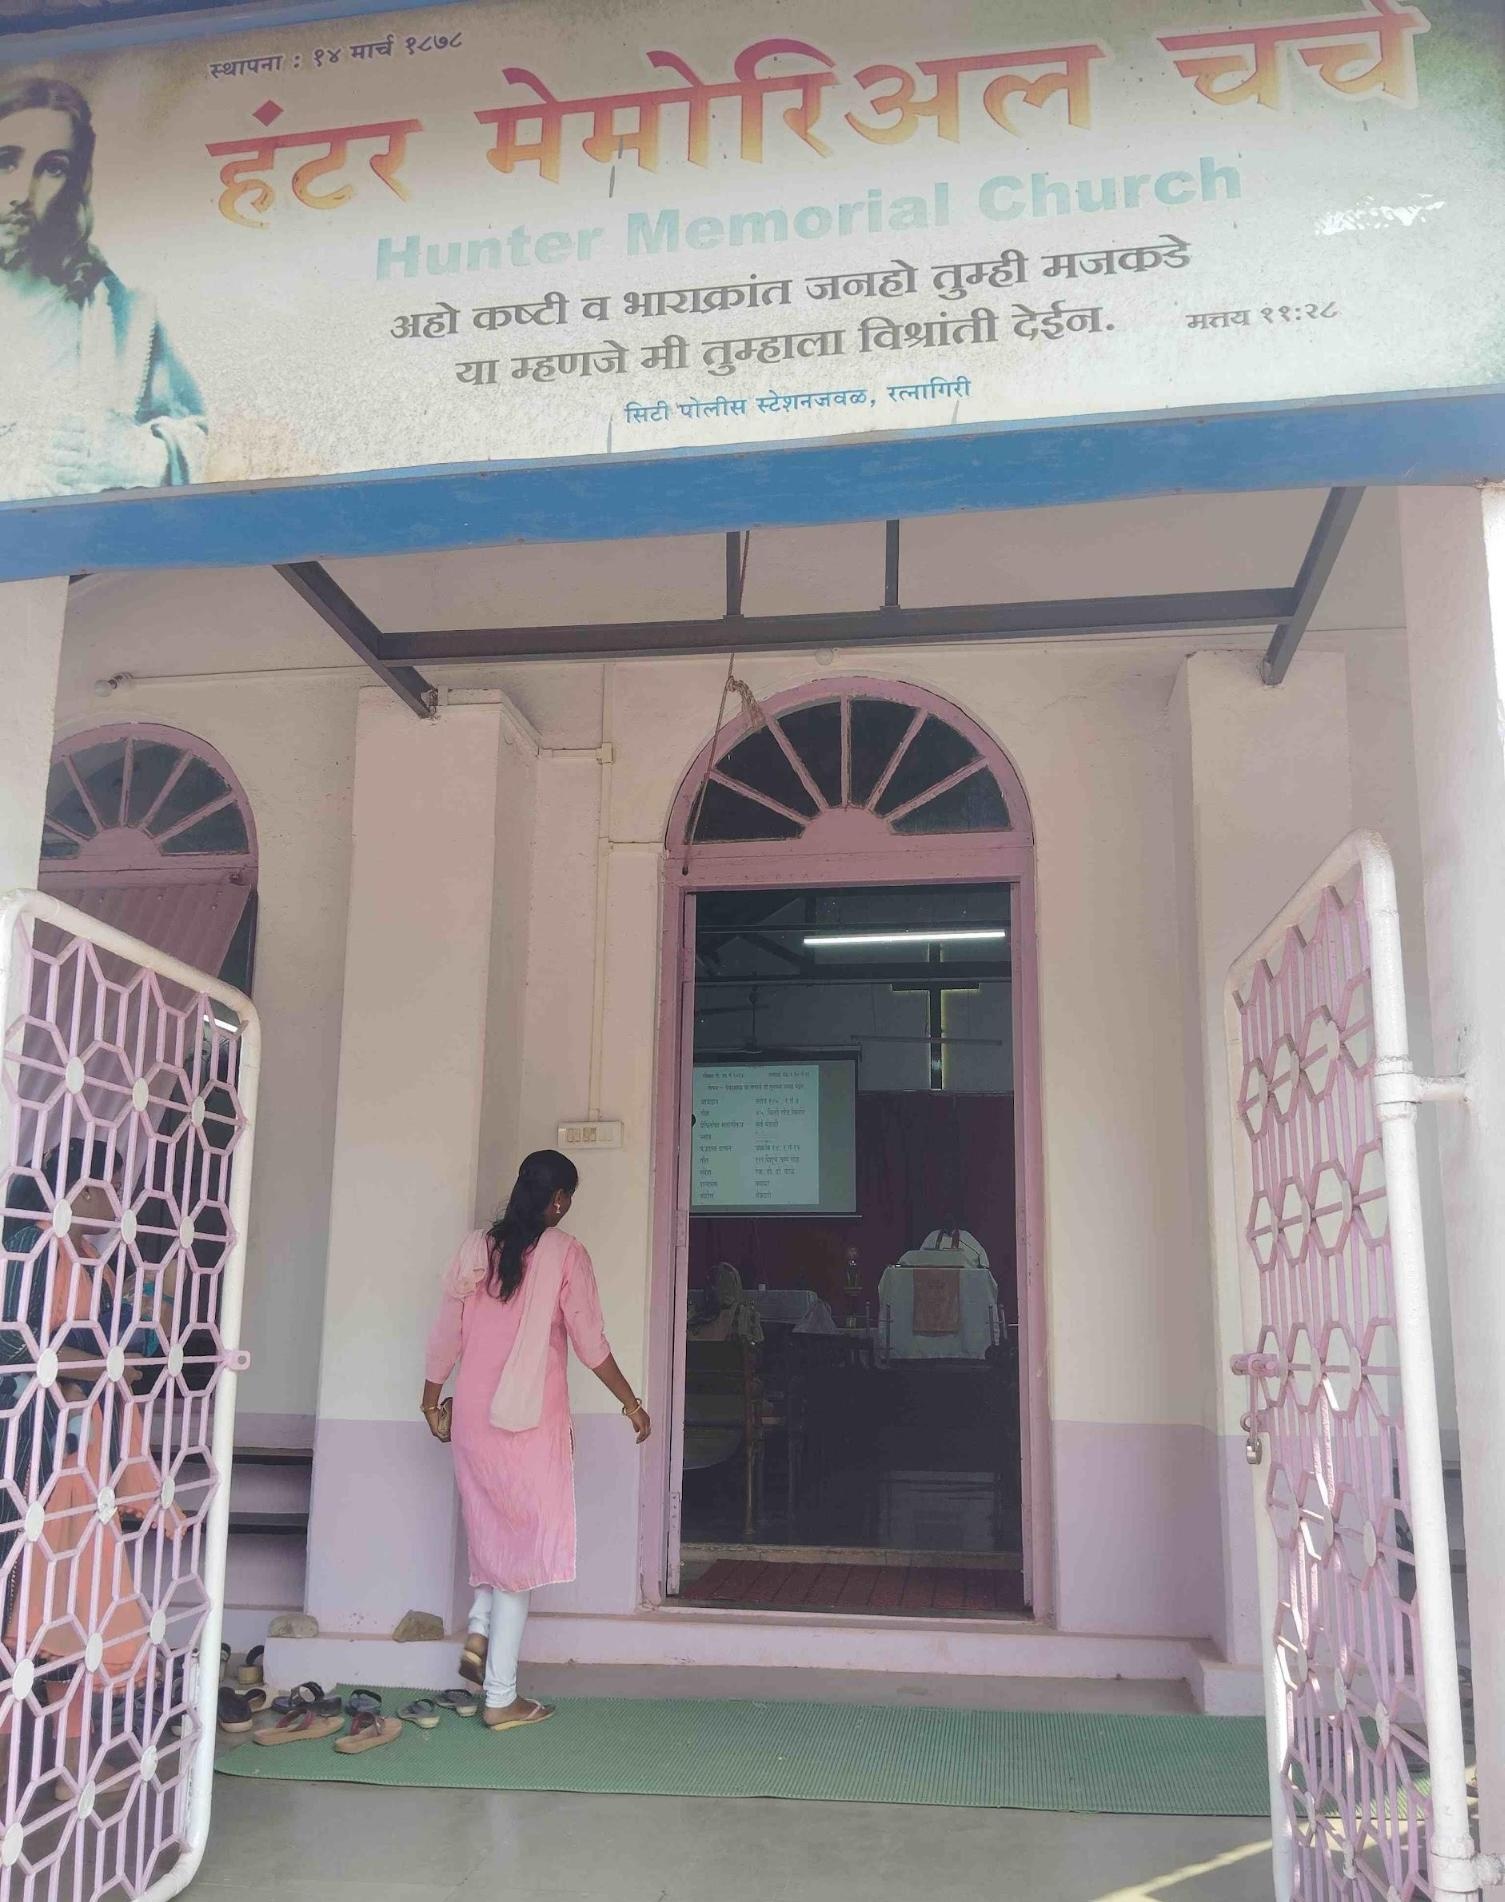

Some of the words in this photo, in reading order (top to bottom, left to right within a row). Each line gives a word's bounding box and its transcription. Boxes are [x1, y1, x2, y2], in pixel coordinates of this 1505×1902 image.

[209, 55, 284, 80] स्थापना
[313, 48, 342, 67] १४
[350, 35, 395, 60] मार्च
[405, 31, 463, 55] १८७८
[205, 99, 424, 229] हंटर
[474, 38, 1106, 184] मेमोरिअल
[376, 224, 604, 281] Hunter
[626, 181, 950, 256] Memorial
[978, 156, 1242, 222] Church
[390, 301, 460, 340] अहो
[471, 290, 569, 331] कष्टी
[581, 295, 611, 321] व
[624, 273, 792, 317] भाराक्रांत
[805, 258, 919, 300] जनहो
[931, 248, 1029, 300] तुम्ही
[1042, 234, 1192, 279] मजकडे
[1185, 309, 1251, 330] मत्तय
[1259, 301, 1338, 324] ११:२८
[455, 358, 500, 386] या
[511, 339, 630, 382] म्हणजे
[640, 334, 690, 371] मी
[702, 329, 846, 377] तुम्हाला
[858, 307, 999, 353] विश्रांती
[1011, 300, 1115, 341] देईन.
[624, 401, 672, 424] सिटी
[679, 395, 747, 418] पोलीस
[755, 389, 877, 413] स्टेशनजवळ,
[886, 375, 973, 402] रत्नागिरी
